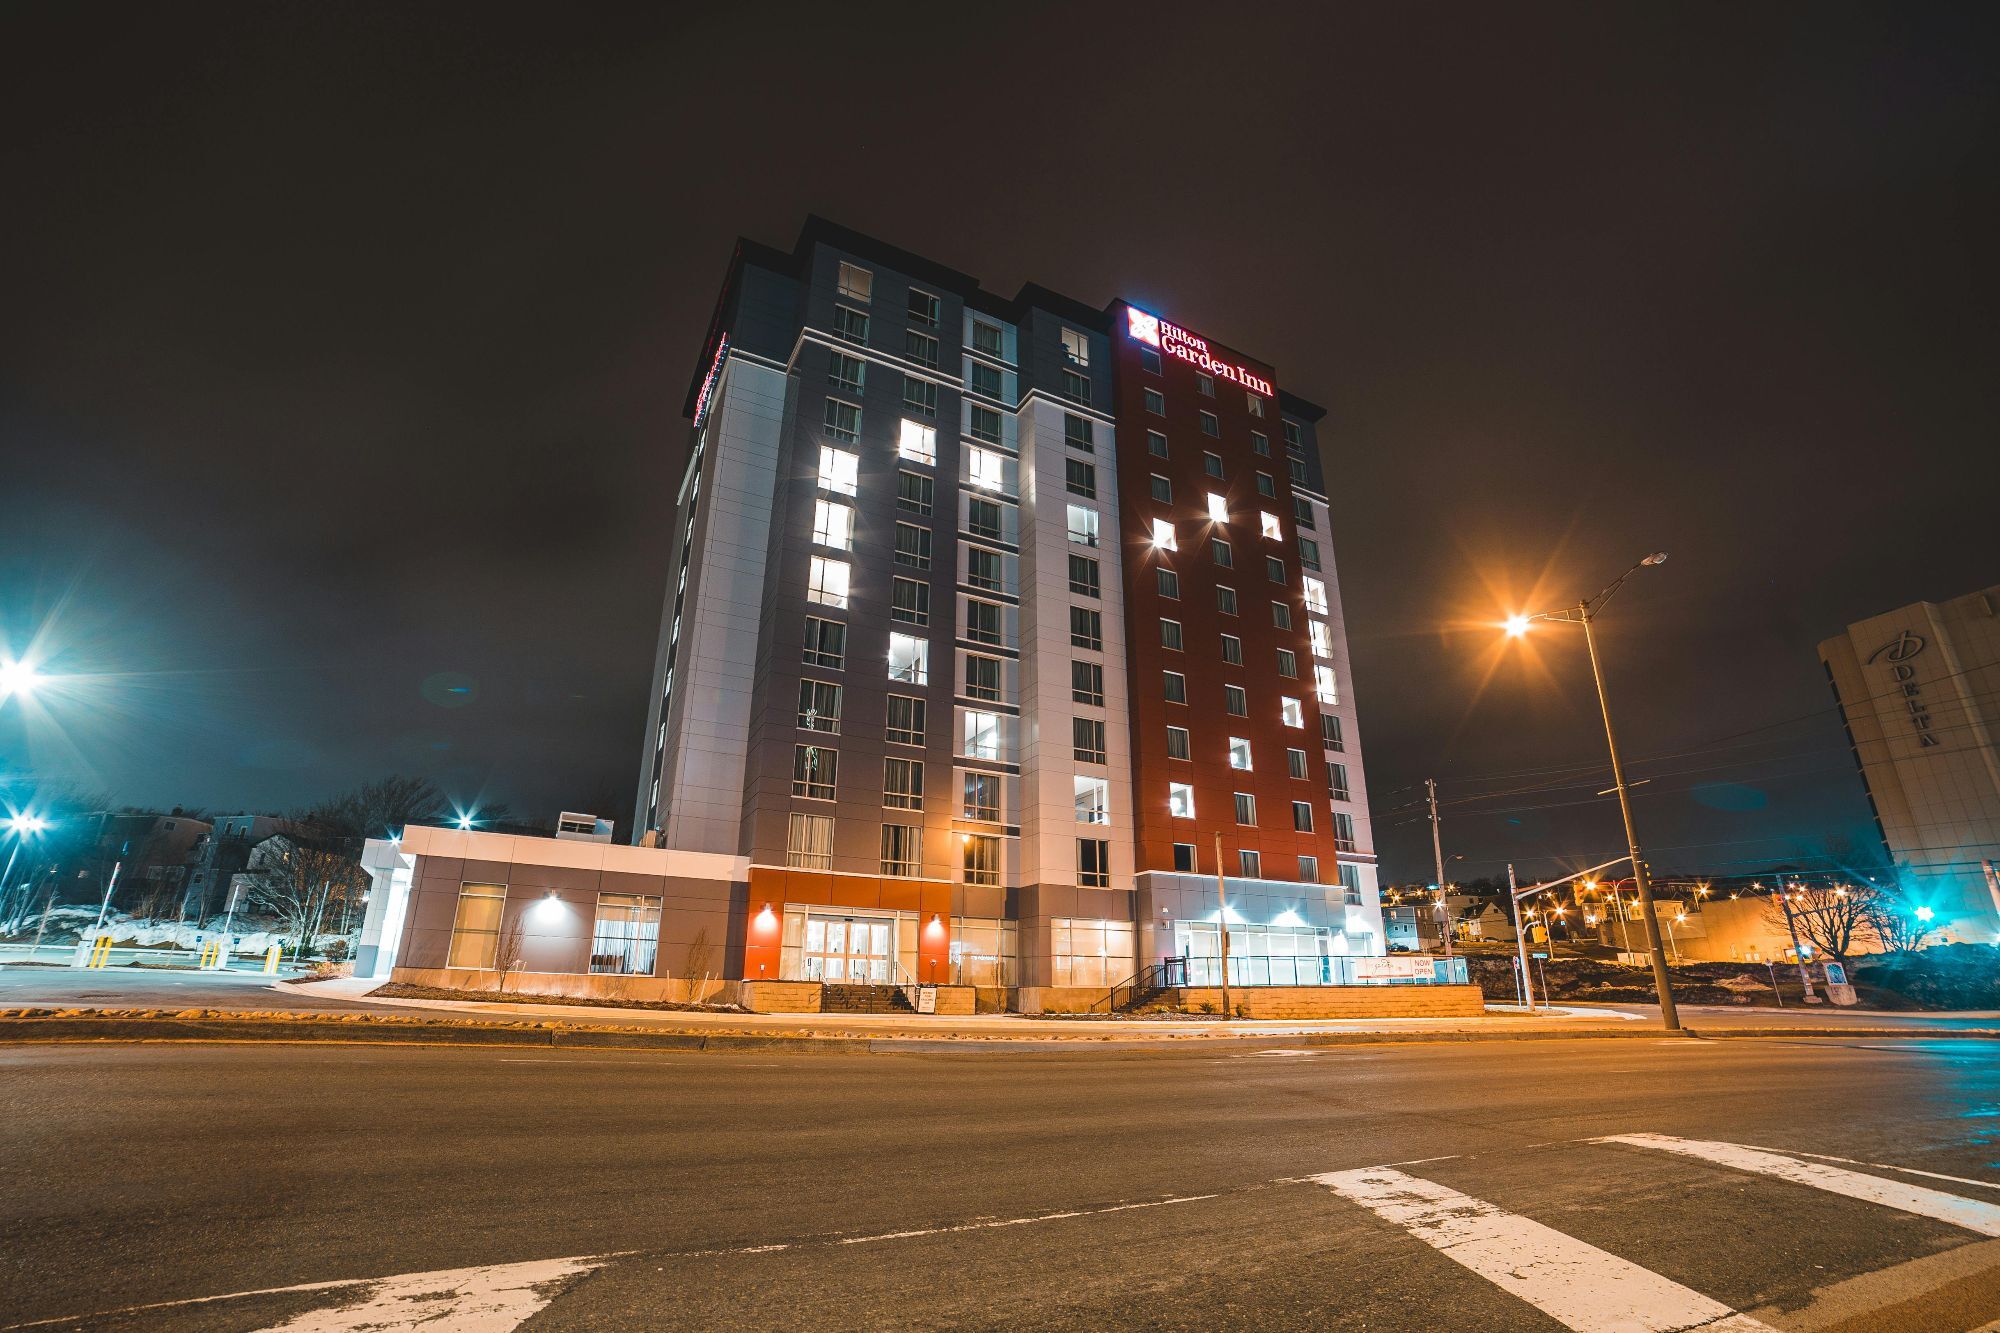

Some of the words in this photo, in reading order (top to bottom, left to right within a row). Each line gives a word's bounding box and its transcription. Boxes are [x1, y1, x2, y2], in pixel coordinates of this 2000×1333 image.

[1160, 320, 1208, 352] Hilton
[1162, 335, 1237, 382] Garden
[1236, 366, 1273, 396] Inn
[1889, 665, 1940, 748] DELTA
[1414, 959, 1431, 967] NOW
